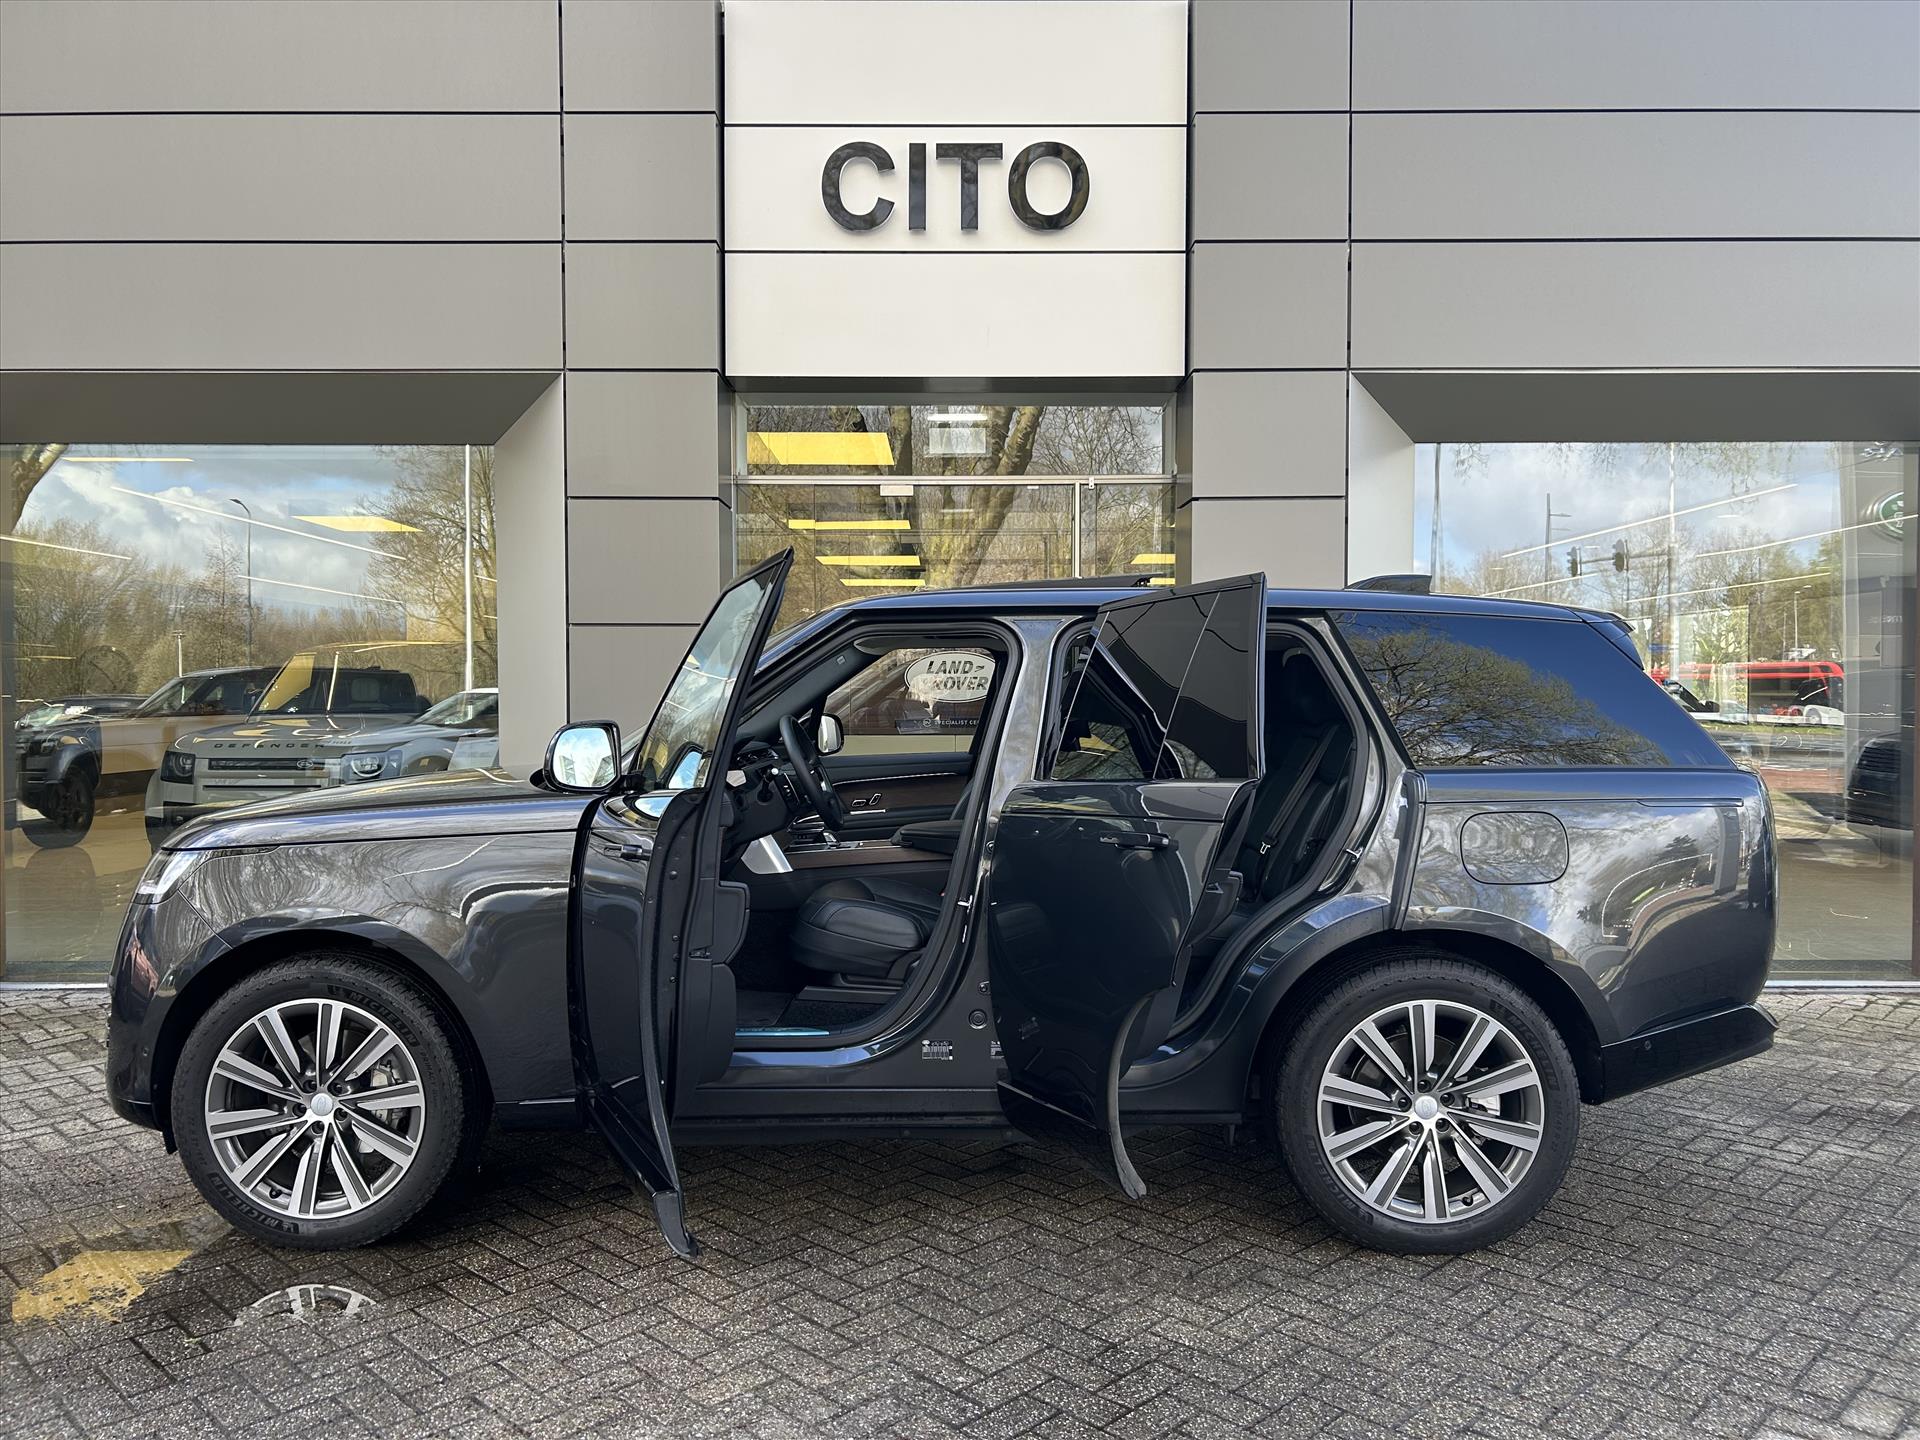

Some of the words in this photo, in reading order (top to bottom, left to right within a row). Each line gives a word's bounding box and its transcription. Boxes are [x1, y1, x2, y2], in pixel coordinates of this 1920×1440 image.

[821, 141, 1090, 232] CITO
[347, 991, 419, 1047] MICHELIN
[1507, 1013, 1560, 1091] MICHELIN
[210, 1175, 280, 1228] MICHELIN
[1306, 1138, 1357, 1210] MICHELIN
